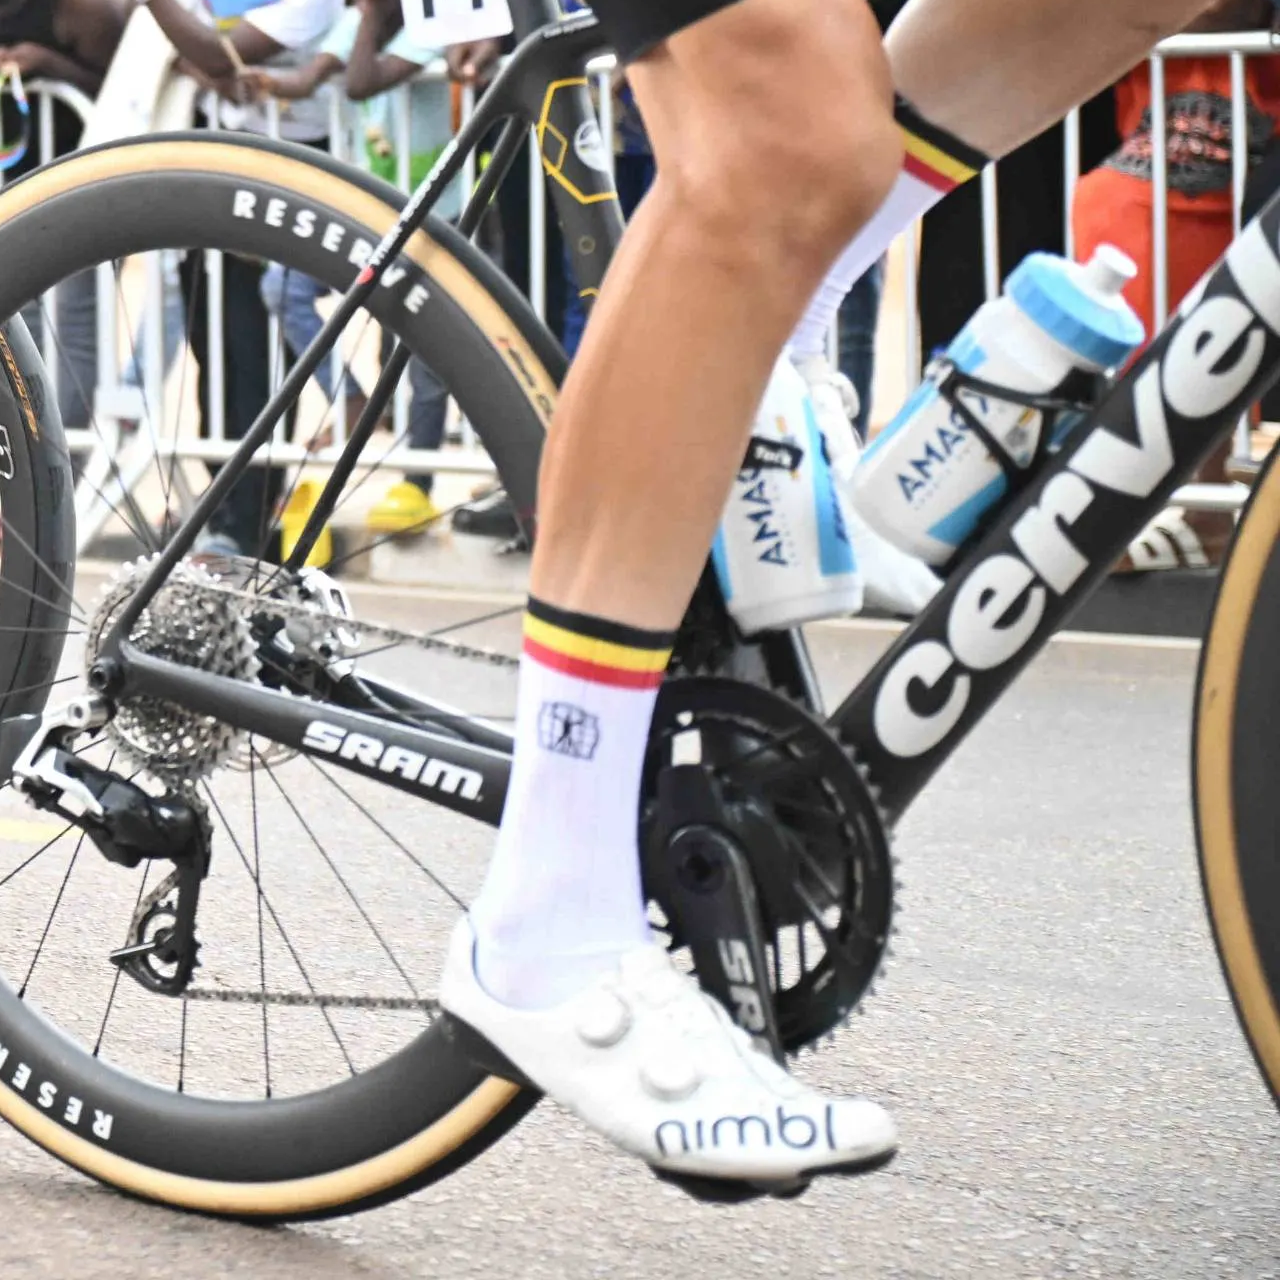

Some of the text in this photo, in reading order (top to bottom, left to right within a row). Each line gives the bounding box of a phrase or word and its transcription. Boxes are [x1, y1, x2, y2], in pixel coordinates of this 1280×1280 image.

[233, 189, 430, 314] RESERVE
[302, 720, 484, 801] SRAM
[655, 1104, 837, 1156] nimbl
